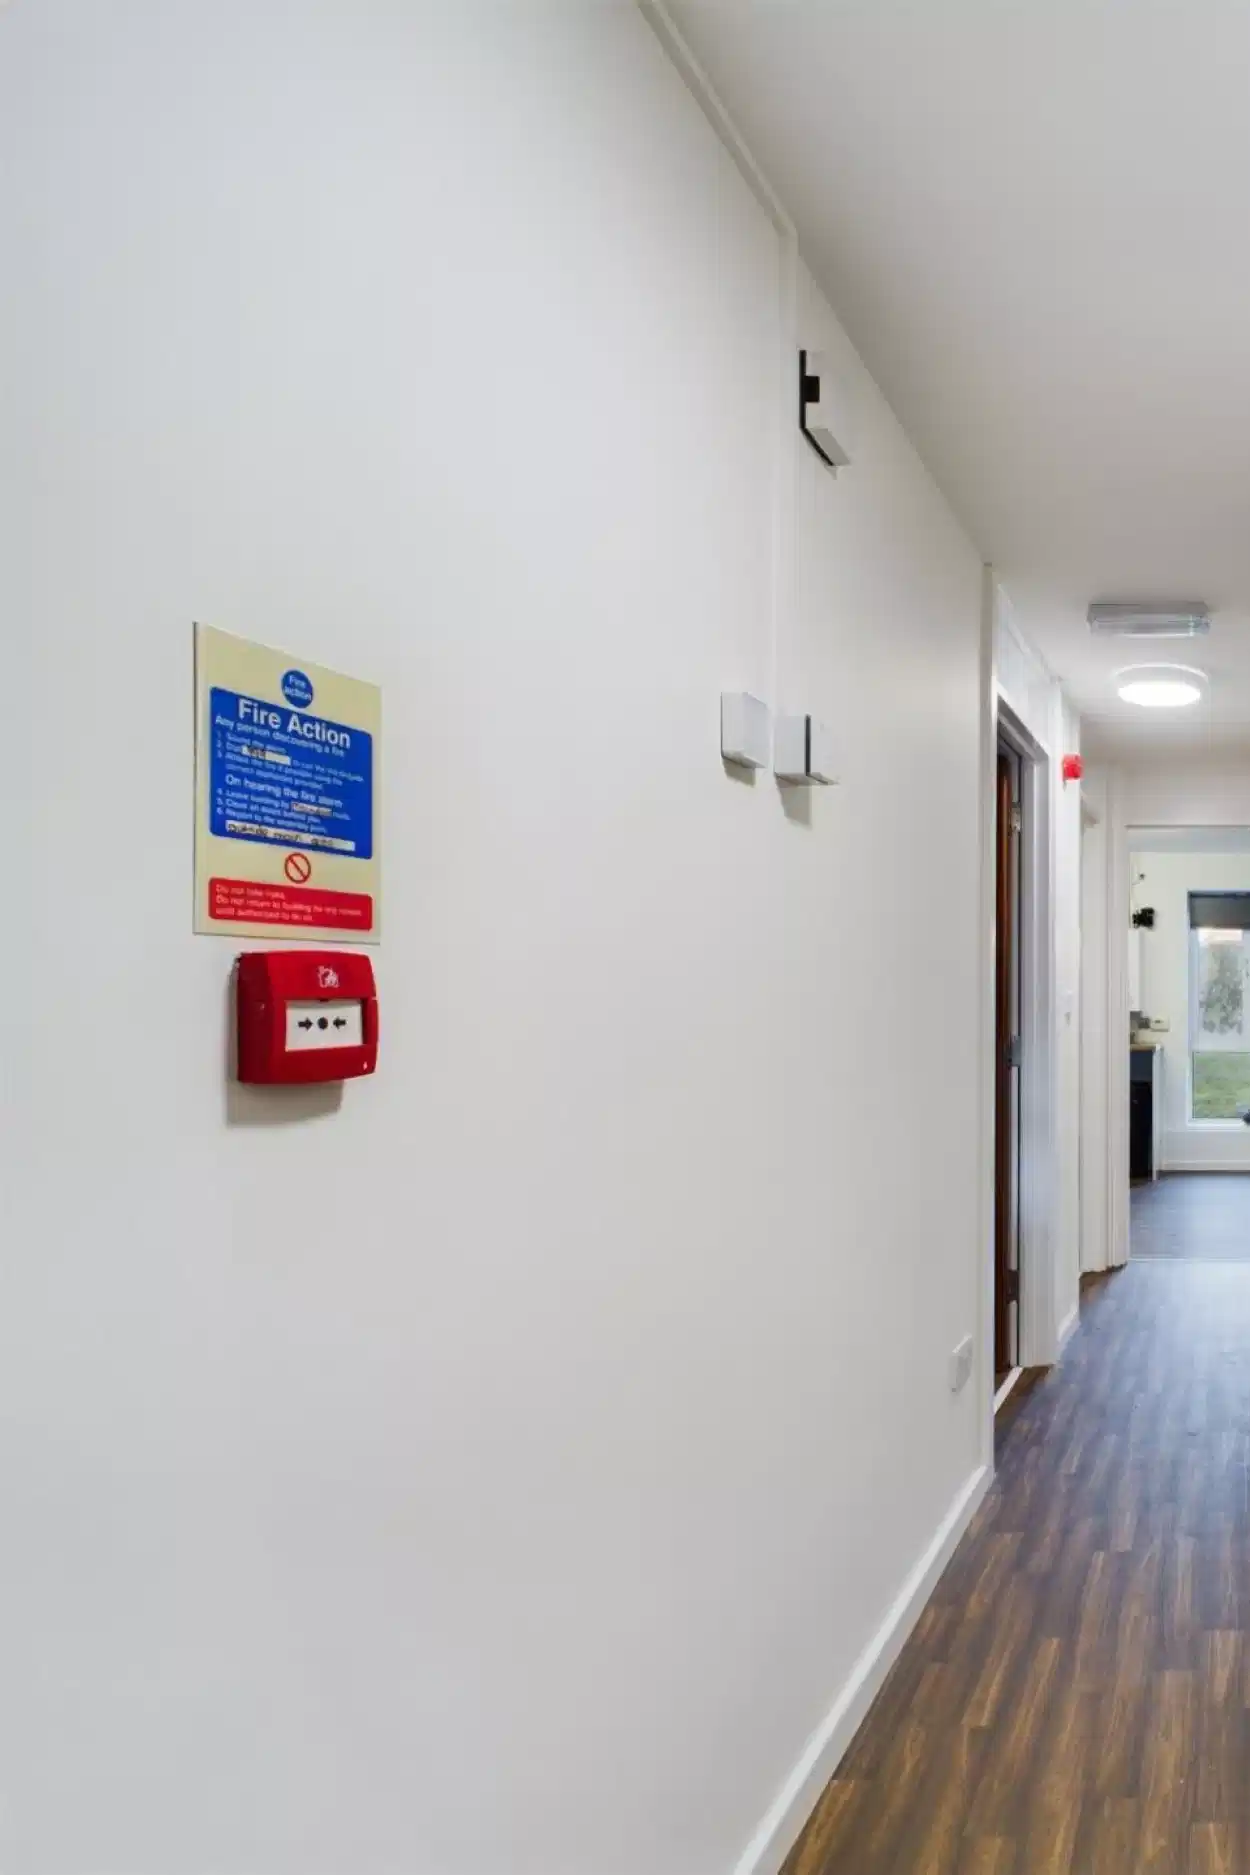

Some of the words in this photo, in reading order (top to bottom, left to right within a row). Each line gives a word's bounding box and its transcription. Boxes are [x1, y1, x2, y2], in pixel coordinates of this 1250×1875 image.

[215, 715, 235, 730] Any
[238, 698, 281, 730] Fire
[287, 713, 351, 749] Action
